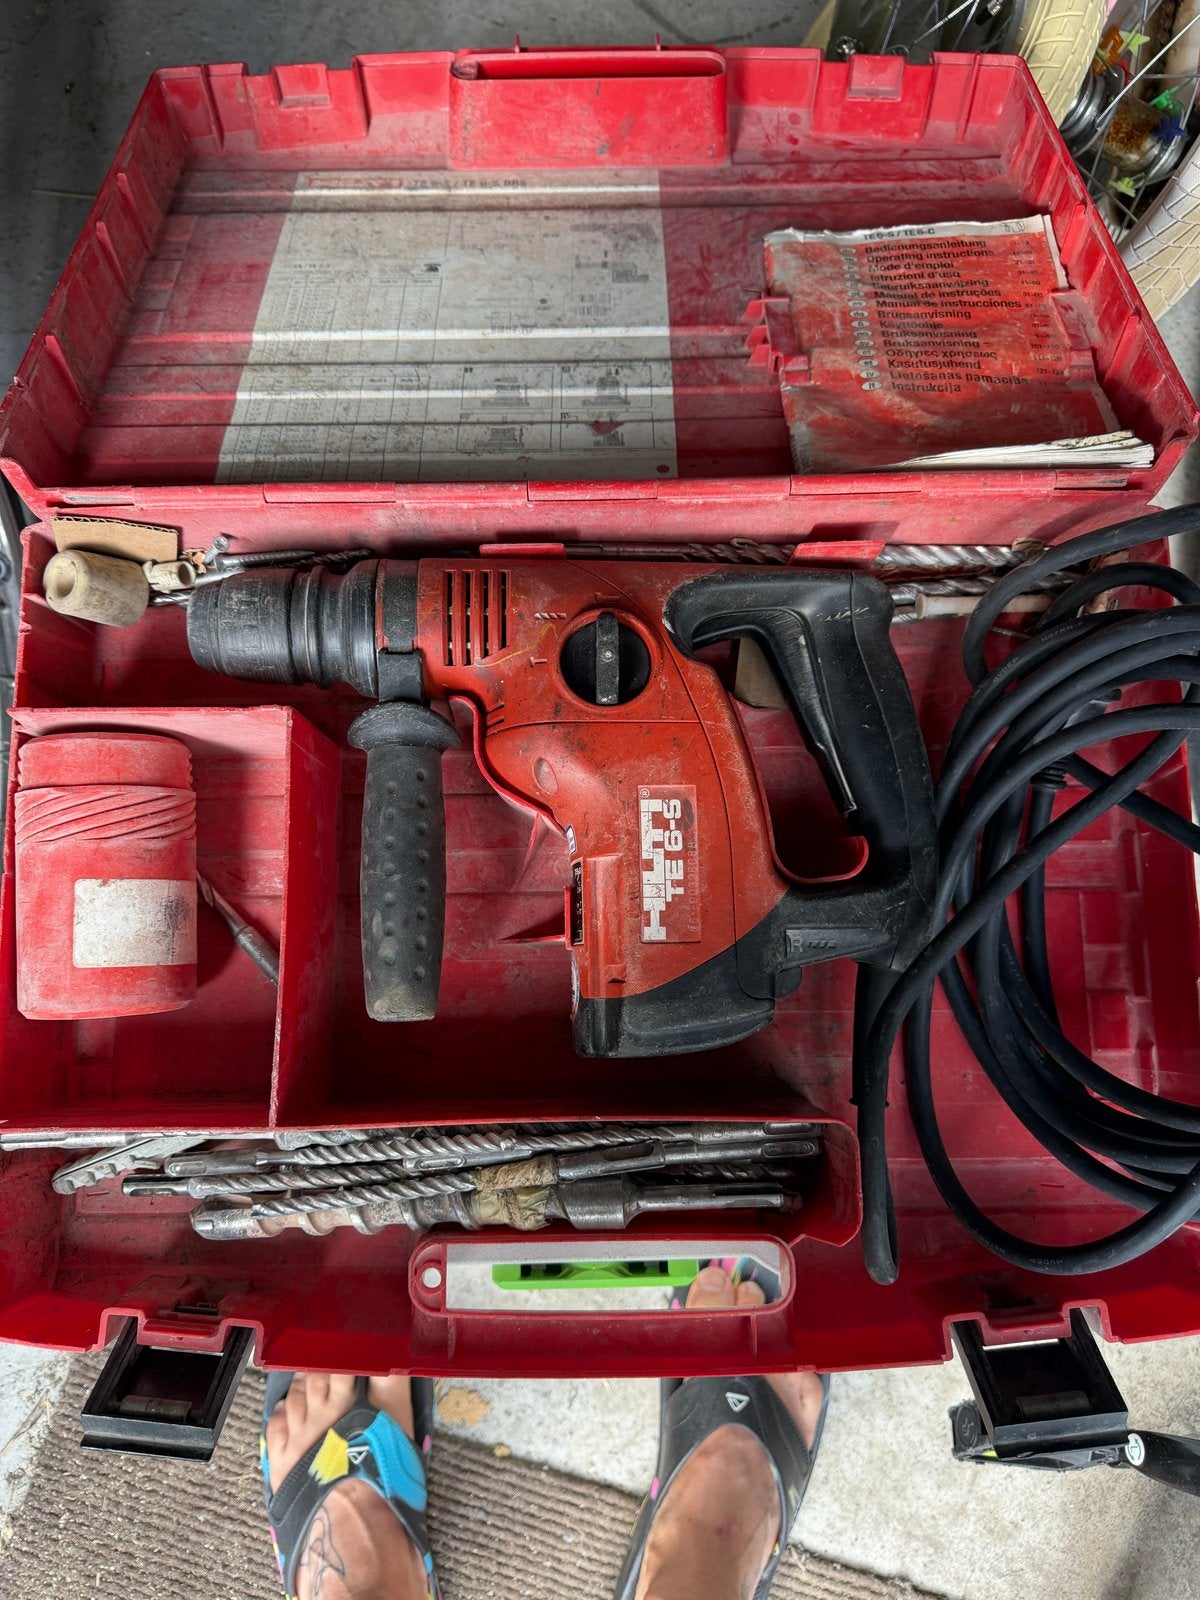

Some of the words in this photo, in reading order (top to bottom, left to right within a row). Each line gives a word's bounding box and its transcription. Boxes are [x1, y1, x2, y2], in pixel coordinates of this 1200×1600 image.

[864, 232, 876, 241] TE
[904, 229, 915, 239] TE
[864, 239, 987, 254] Bedienungsanleitung
[867, 249, 923, 263] Operating
[925, 248, 995, 259] instructions
[868, 263, 901, 273] Mode
[903, 260, 954, 273] d'emploi
[870, 271, 928, 281] Istruzioni
[872, 278, 989, 291] Gebruiksaanwijzing
[874, 290, 918, 299] Manual
[921, 289, 935, 298] de
[939, 288, 1001, 298] instruções
[876, 299, 919, 308] Manual
[923, 299, 938, 308] de
[941, 298, 1021, 309] instrucciones
[877, 309, 971, 320] Brugsanvisning
[879, 320, 944, 330] Käyttöohje
[881, 329, 977, 339] Bruksanvisning
[884, 338, 980, 348] Bruksanvisning
[888, 359, 981, 370] Kasutusjuhend
[890, 370, 962, 381] Lietošanas
[892, 381, 961, 394] Instrukcija
[662, 798, 684, 852] 6-S
[640, 799, 667, 941] HILTI
[665, 859, 685, 902] TE
